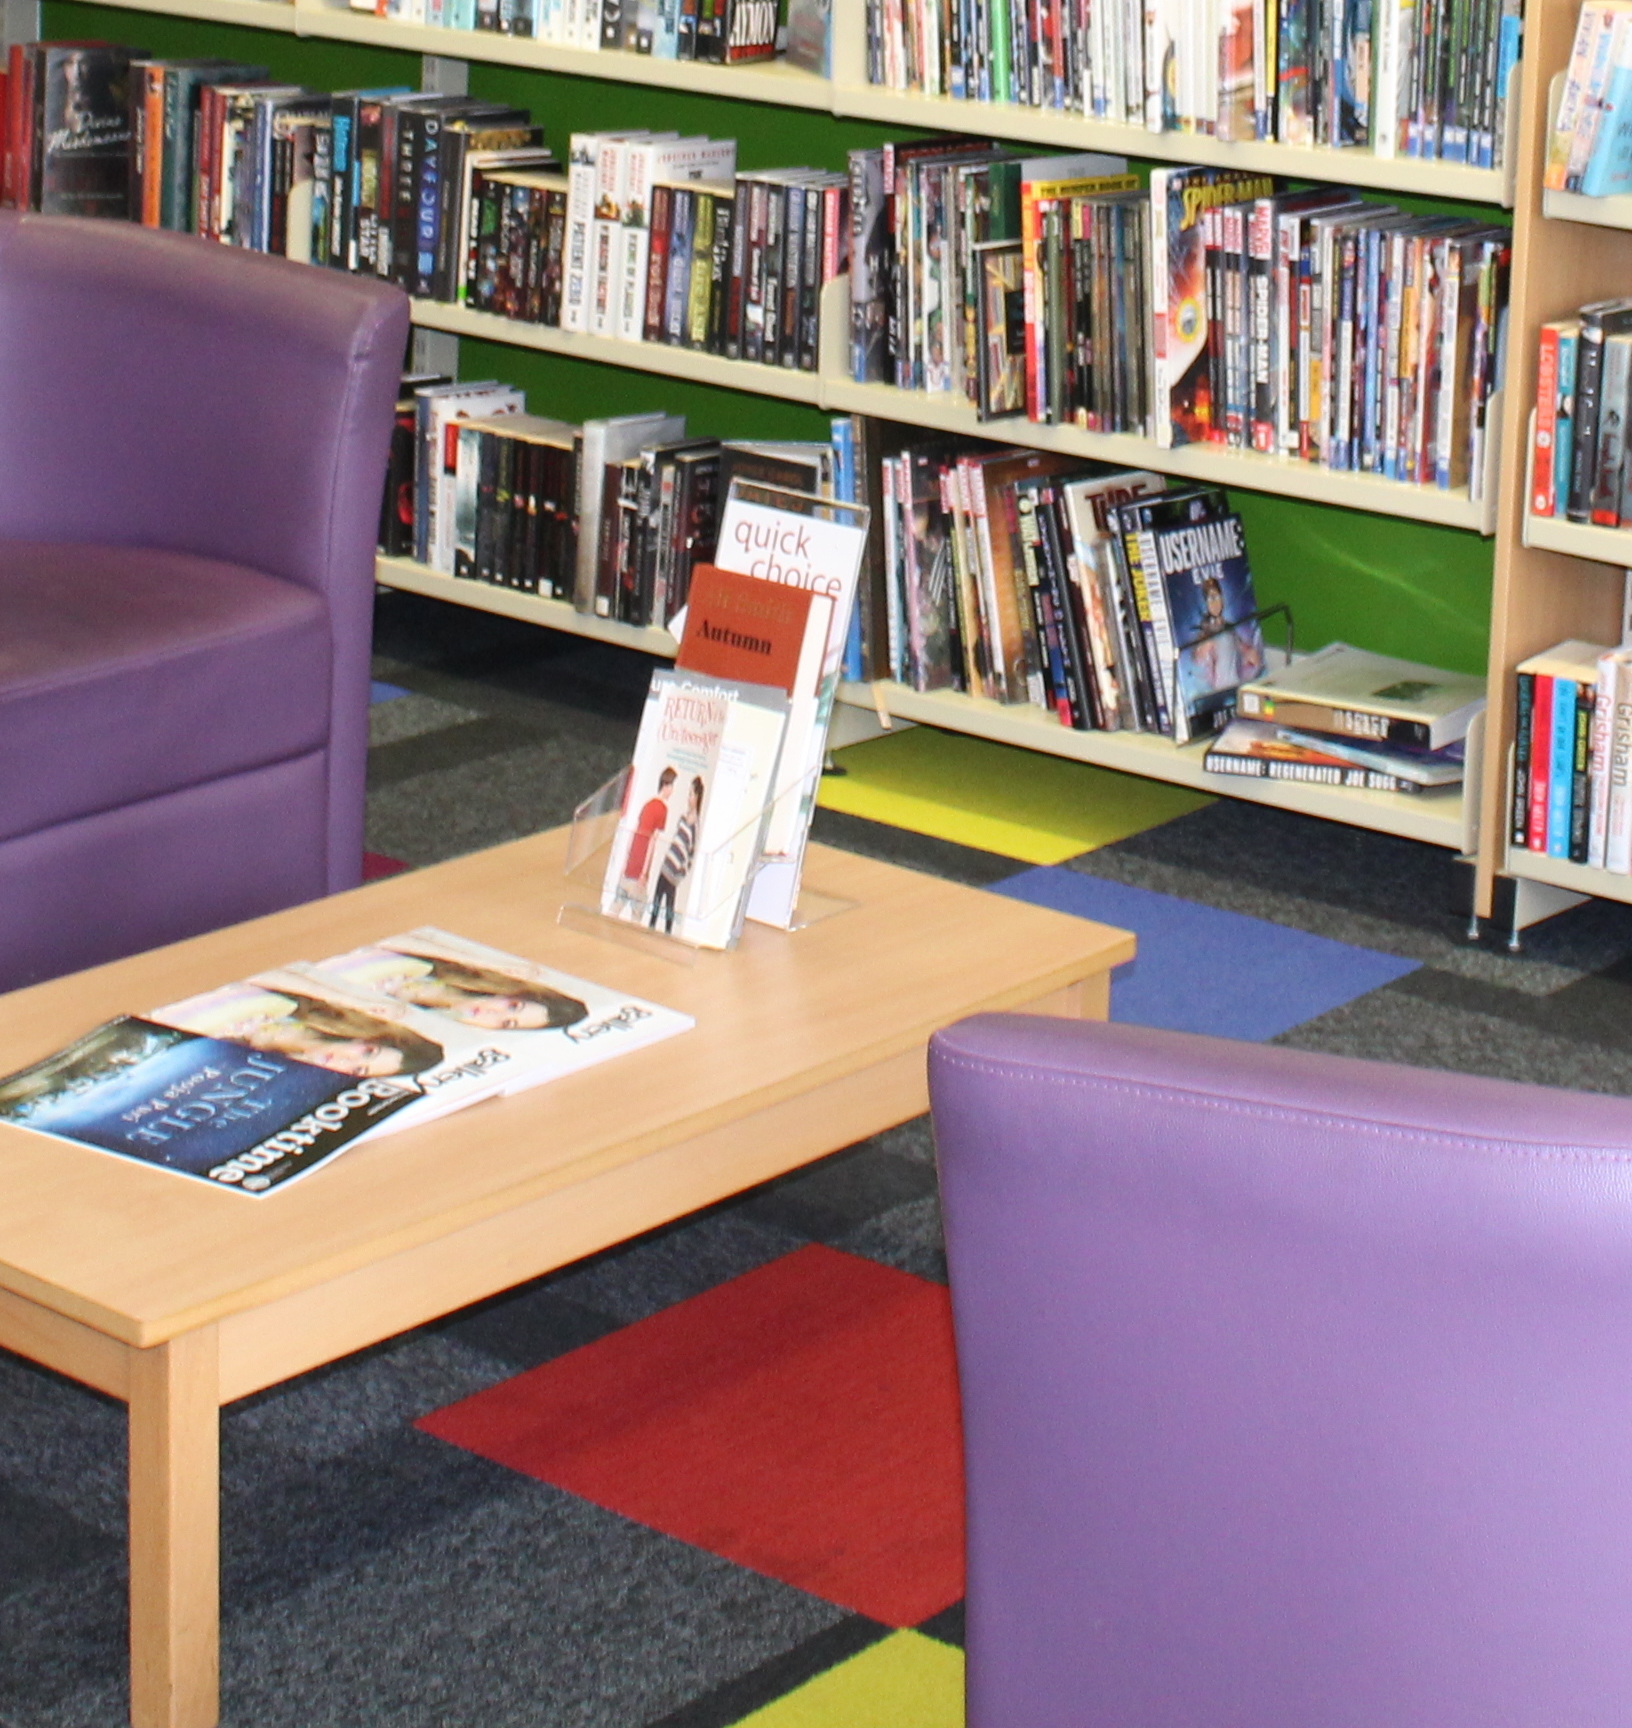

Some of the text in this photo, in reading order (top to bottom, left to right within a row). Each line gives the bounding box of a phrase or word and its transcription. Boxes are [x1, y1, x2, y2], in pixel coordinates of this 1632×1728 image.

[1181, 176, 1275, 230] SPIDER-MAN
[734, 520, 812, 560] quick
[1158, 519, 1246, 574] USERNAME:
[750, 554, 843, 595] choice
[1125, 533, 1152, 622] THE JOKER
[697, 620, 772, 656] Autumn
[665, 697, 715, 725] RETURN
[1589, 694, 1613, 773] Grisham
[1269, 759, 1342, 787] REGENERATED
[123, 1052, 287, 1148] JUNGLE
[209, 1077, 400, 1184] Booktime
